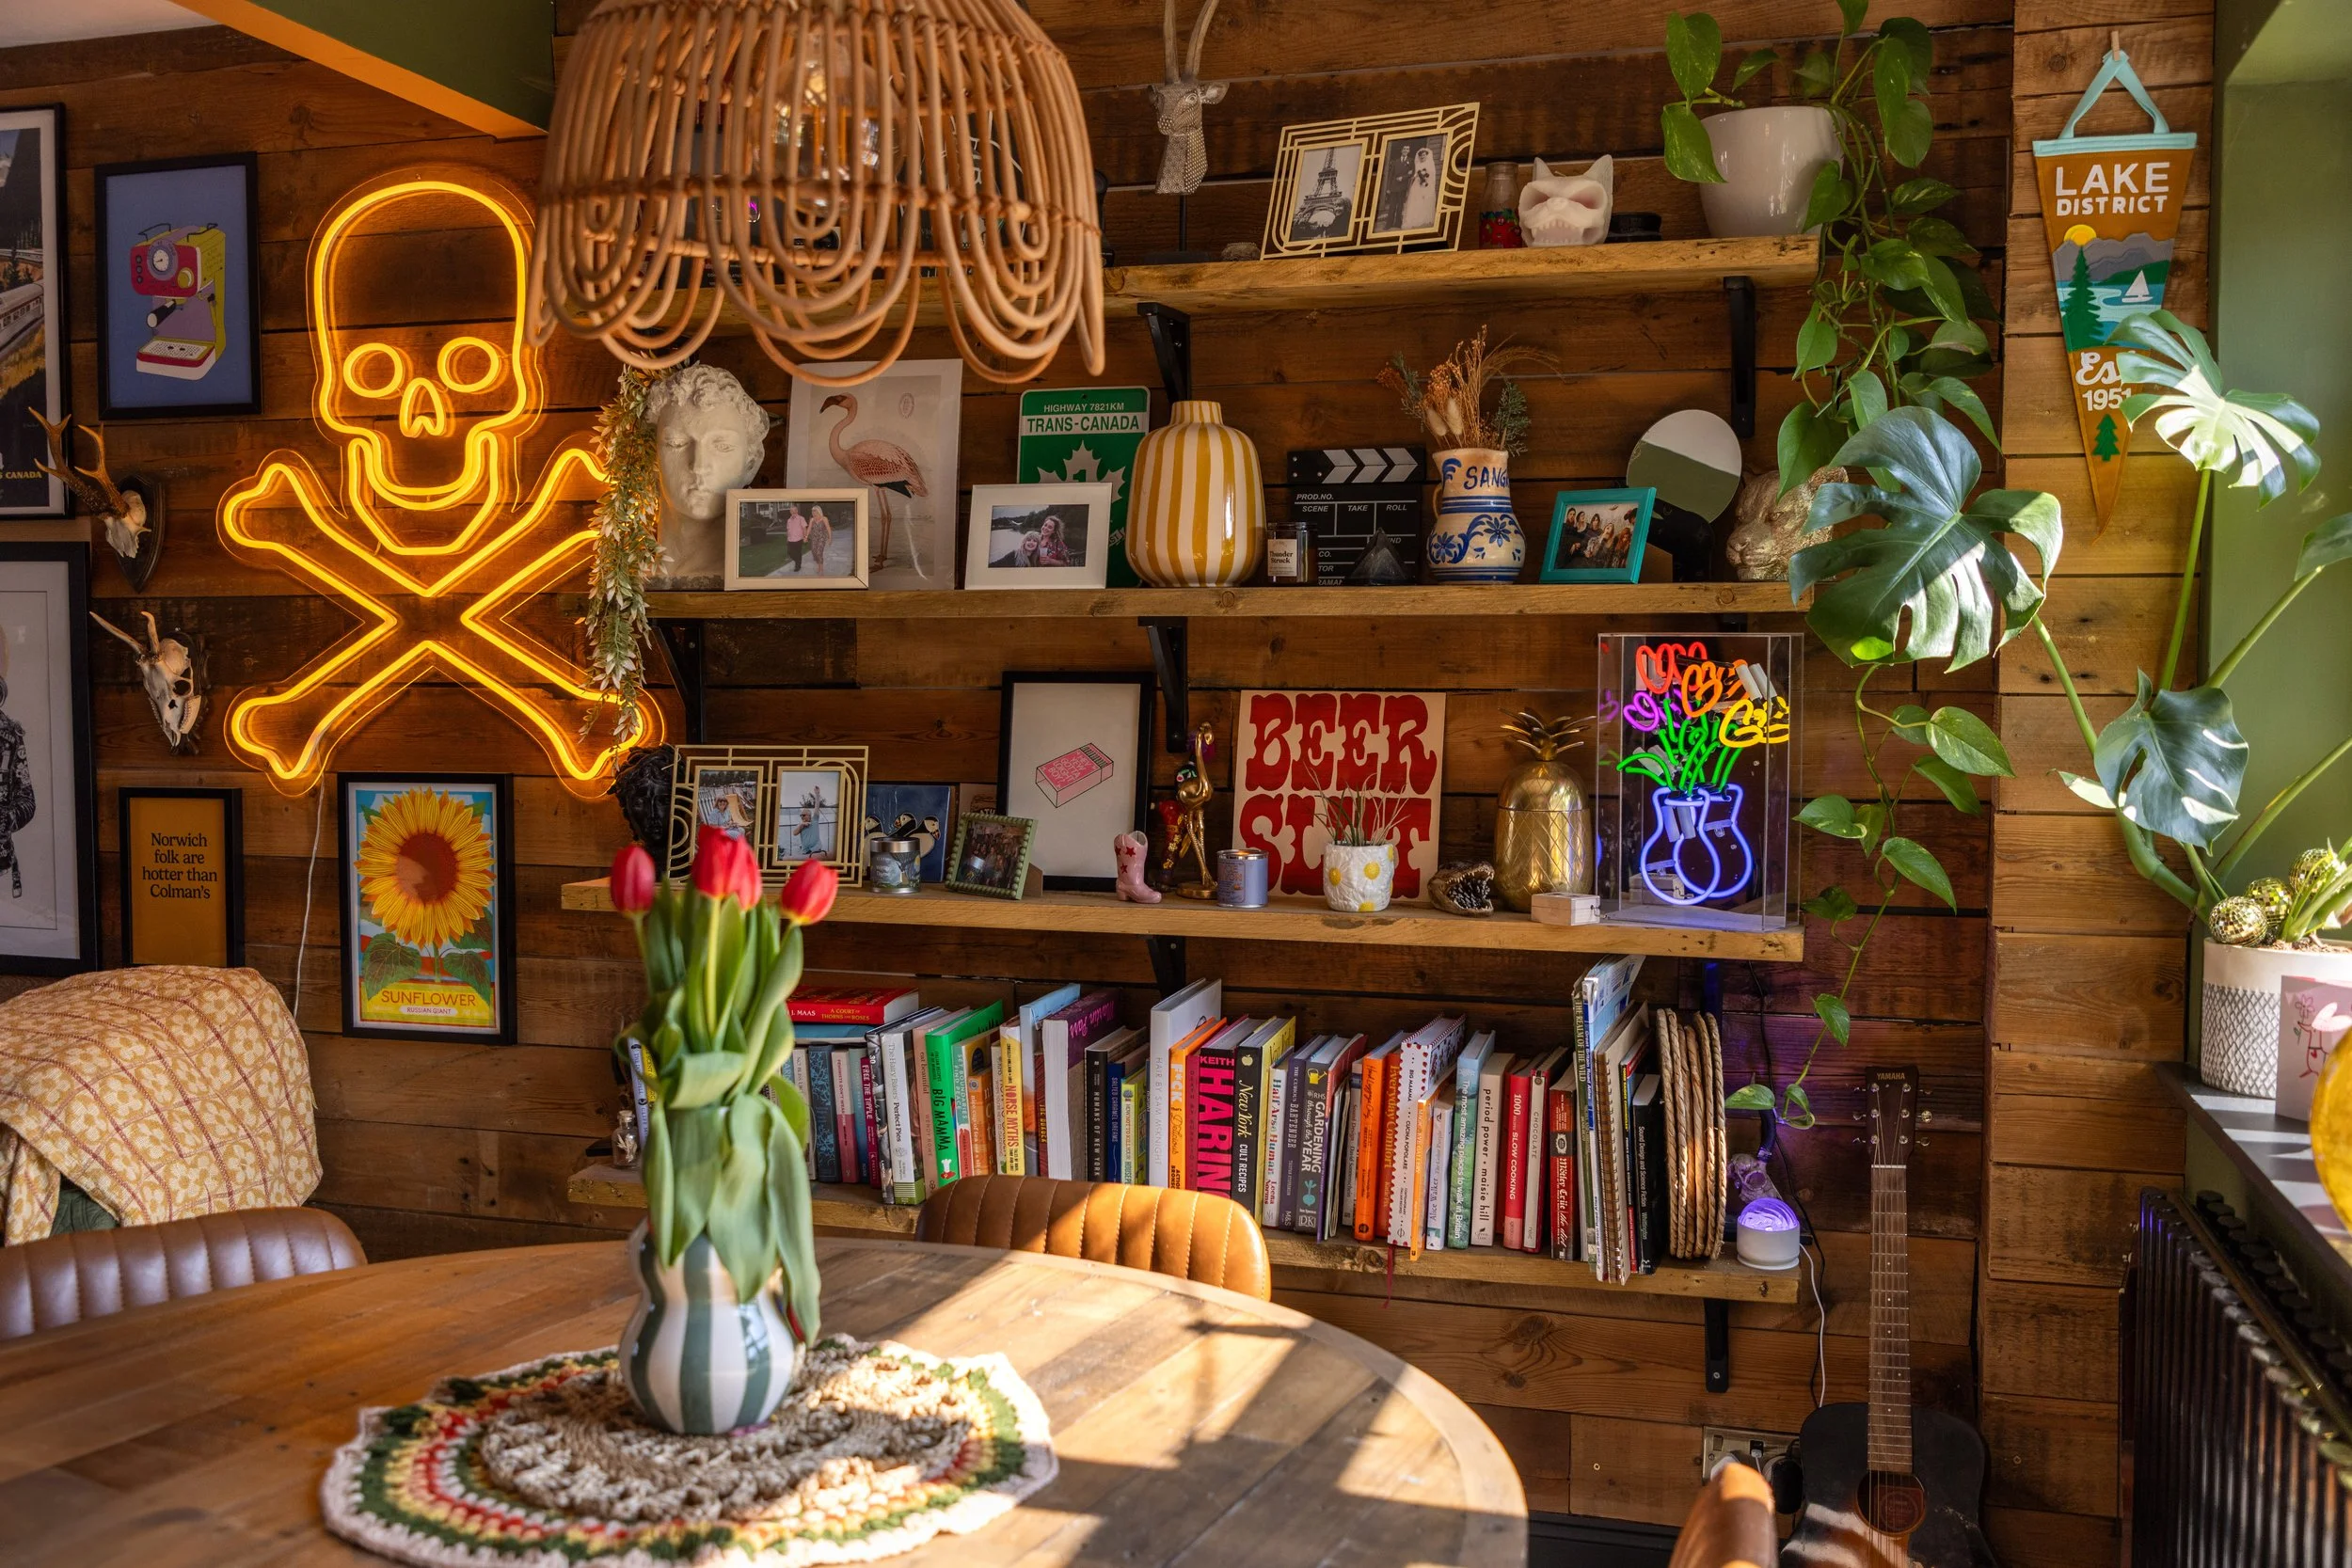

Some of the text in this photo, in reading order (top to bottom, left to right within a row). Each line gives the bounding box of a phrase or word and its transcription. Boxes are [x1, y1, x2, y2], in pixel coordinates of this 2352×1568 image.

[2055, 162, 2170, 196] LAKE
[2056, 196, 2168, 217] DISTRICT
[2075, 351, 2124, 387] Es
[1043, 403, 1124, 412] HIGHWAY 7821KM
[1027, 415, 1139, 433] TRANS-CANADA
[5, 470, 42, 479] CANADA
[1246, 693, 1438, 795] BEER
[151, 832, 208, 847] Norwich
[154, 849, 205, 863] folk are
[142, 865, 217, 881] hotter than
[151, 884, 211, 899] Colman's
[381, 990, 476, 1006] SUNFLOWER
[1576, 1015, 1584, 1037] REALM
[1578, 1039, 1584, 1049] OF
[869, 1054, 876, 1064] 30
[1200, 1055, 1235, 1066] KEITH
[959, 1069, 967, 1119] BOUNDARIES
[1154, 1057, 1163, 1116] HAIR BY SAM
[1271, 1079, 1281, 1105] Half
[1313, 1092, 1326, 1101] RHS
[1462, 1081, 1470, 1096] The
[865, 1096, 873, 1119] TIPPLE
[1005, 1085, 1020, 1148] NORSE MYTHS
[1384, 1066, 1400, 1168] Everyday Comfort
[1513, 1094, 1522, 1115] 1000
[932, 1088, 952, 1150] BIG MAMMA
[1093, 1124, 1101, 1133] OF
[1271, 1105, 1279, 1132] Arse
[1287, 1103, 1299, 1148] BARTENDER
[1171, 1113, 1184, 1155] Delicious
[1197, 1067, 1234, 1199] HARIN
[1237, 1080, 1254, 1193] New York CULT RECIPES
[1301, 1100, 1314, 1172] through the YEAR
[1311, 1101, 1326, 1174] GARDENING
[1457, 1116, 1467, 1149] amazing
[1456, 1150, 1465, 1176] places
[1479, 1088, 1495, 1221] period power maisie hill
[1457, 1177, 1463, 1185] to
[1509, 1159, 1518, 1200] COOKING
[1429, 1178, 1438, 1221] Alice Walker
[1456, 1185, 1465, 1204] walk
[1559, 1158, 1569, 1248] Mötley Crüe the dirt
[1299, 1215, 1316, 1227] DK
[1455, 1204, 1463, 1214] in
[1454, 1214, 1463, 1239] Britain
